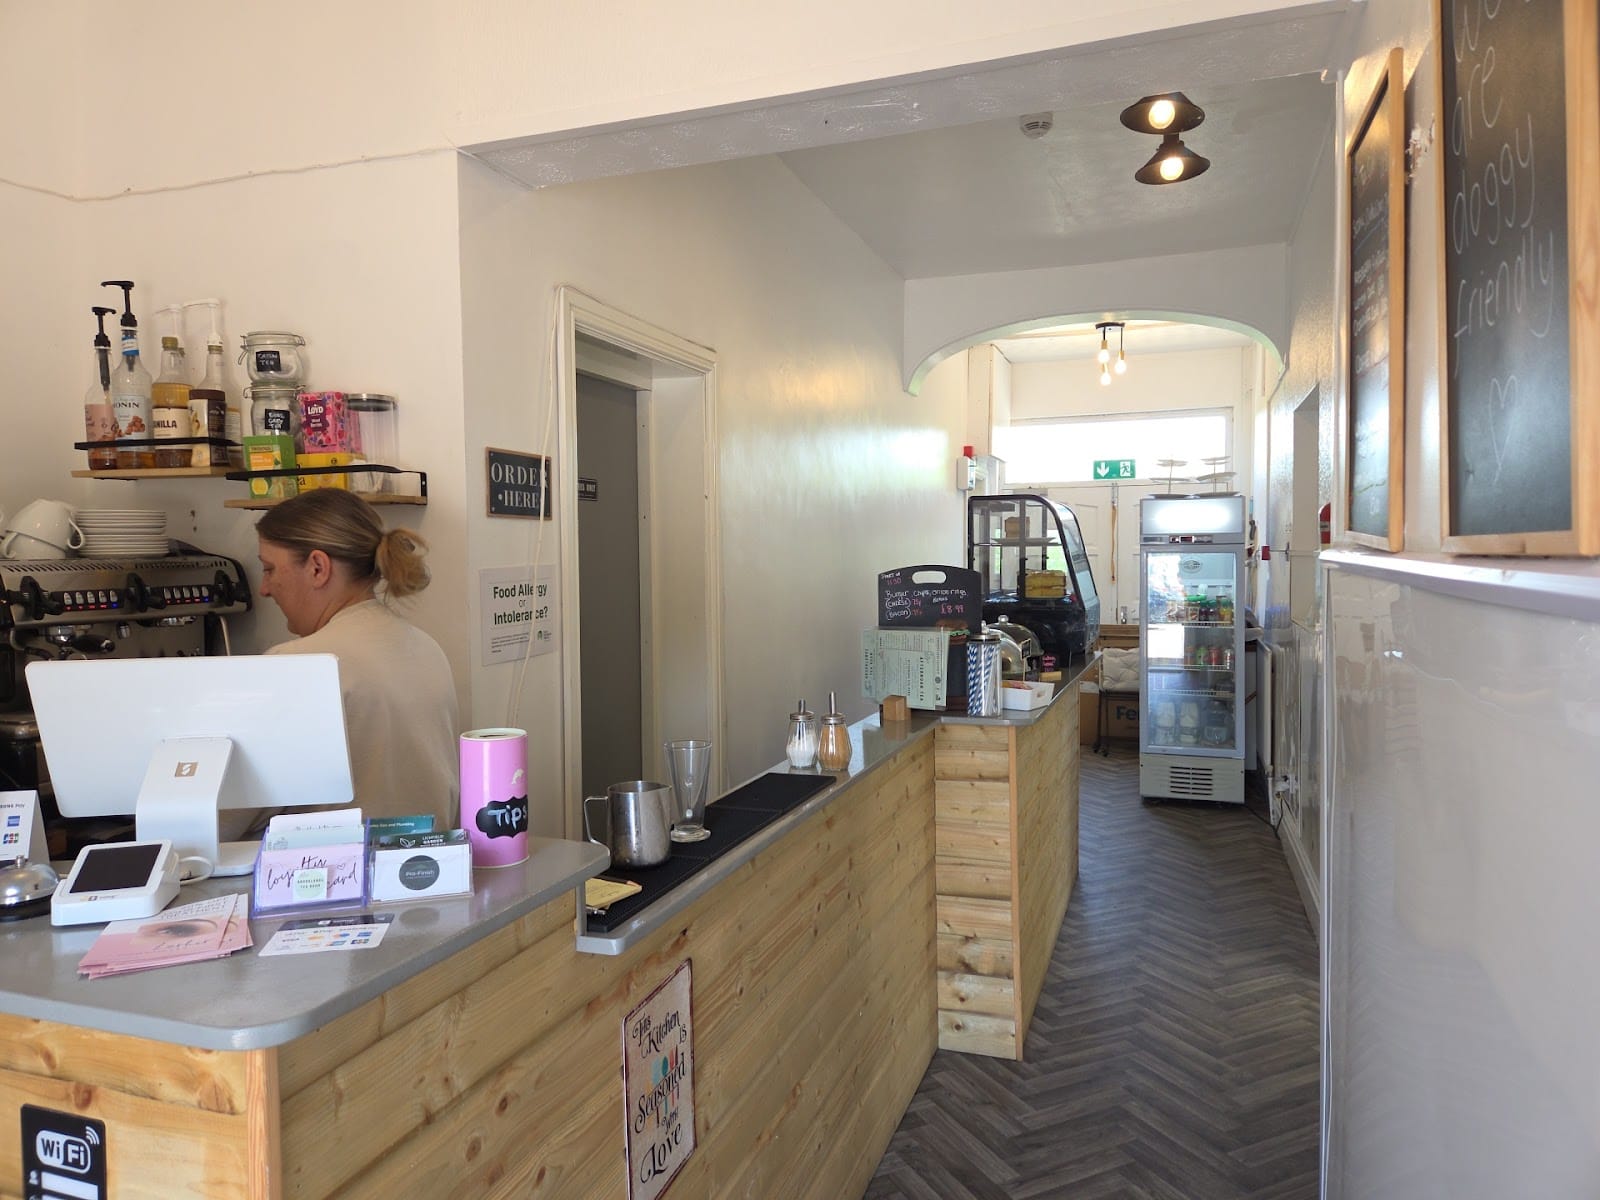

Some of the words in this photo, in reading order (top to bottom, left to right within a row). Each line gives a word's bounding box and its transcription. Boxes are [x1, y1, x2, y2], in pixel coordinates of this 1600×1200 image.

[1452, 46, 1502, 158] are
[1453, 113, 1536, 254] doggy
[1454, 225, 1553, 378] friendly
[493, 585, 516, 599] Food
[519, 599, 526, 607] or
[487, 804, 527, 830] Tips
[635, 1052, 686, 1133] Seasoned
[40, 1138, 85, 1166] WiFi
[640, 1123, 683, 1184] Love
